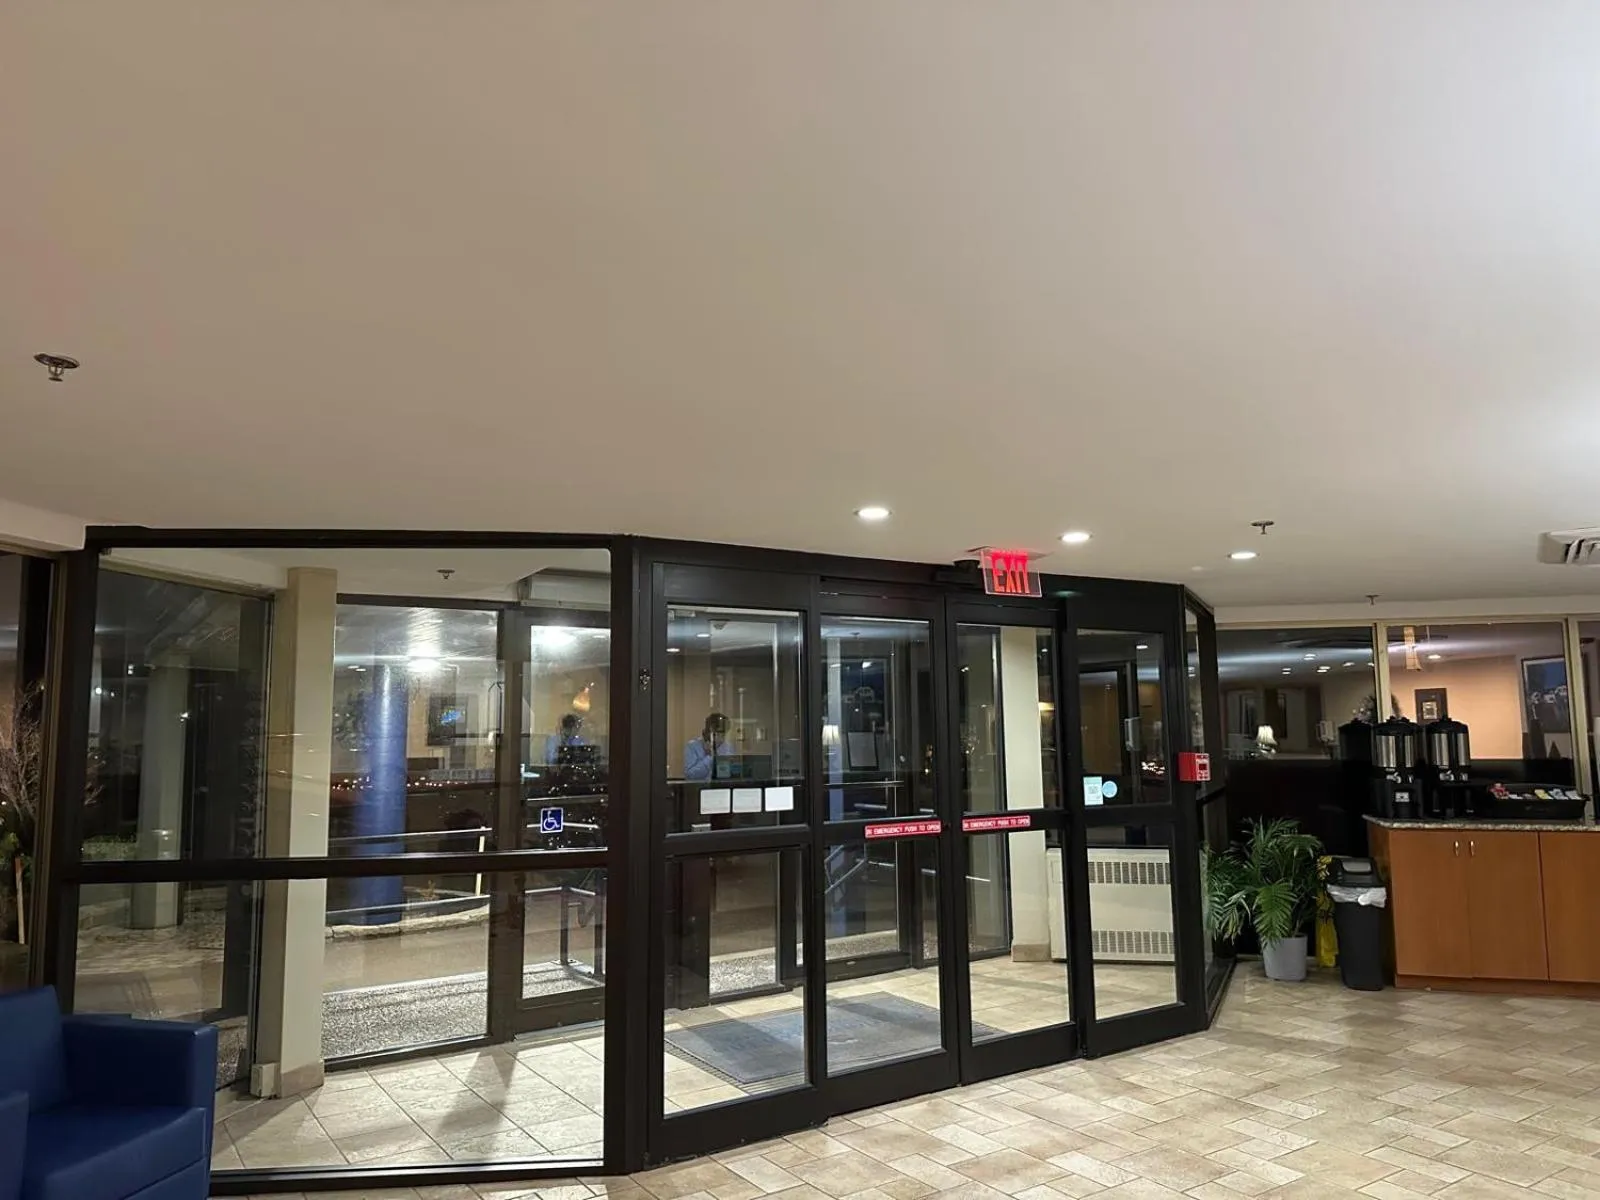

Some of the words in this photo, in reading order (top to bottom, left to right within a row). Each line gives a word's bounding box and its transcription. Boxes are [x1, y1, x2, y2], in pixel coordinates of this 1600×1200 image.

[991, 551, 1030, 594] EXIT
[970, 820, 996, 829] EMERGENCY
[873, 826, 903, 835] EMERGENCY
